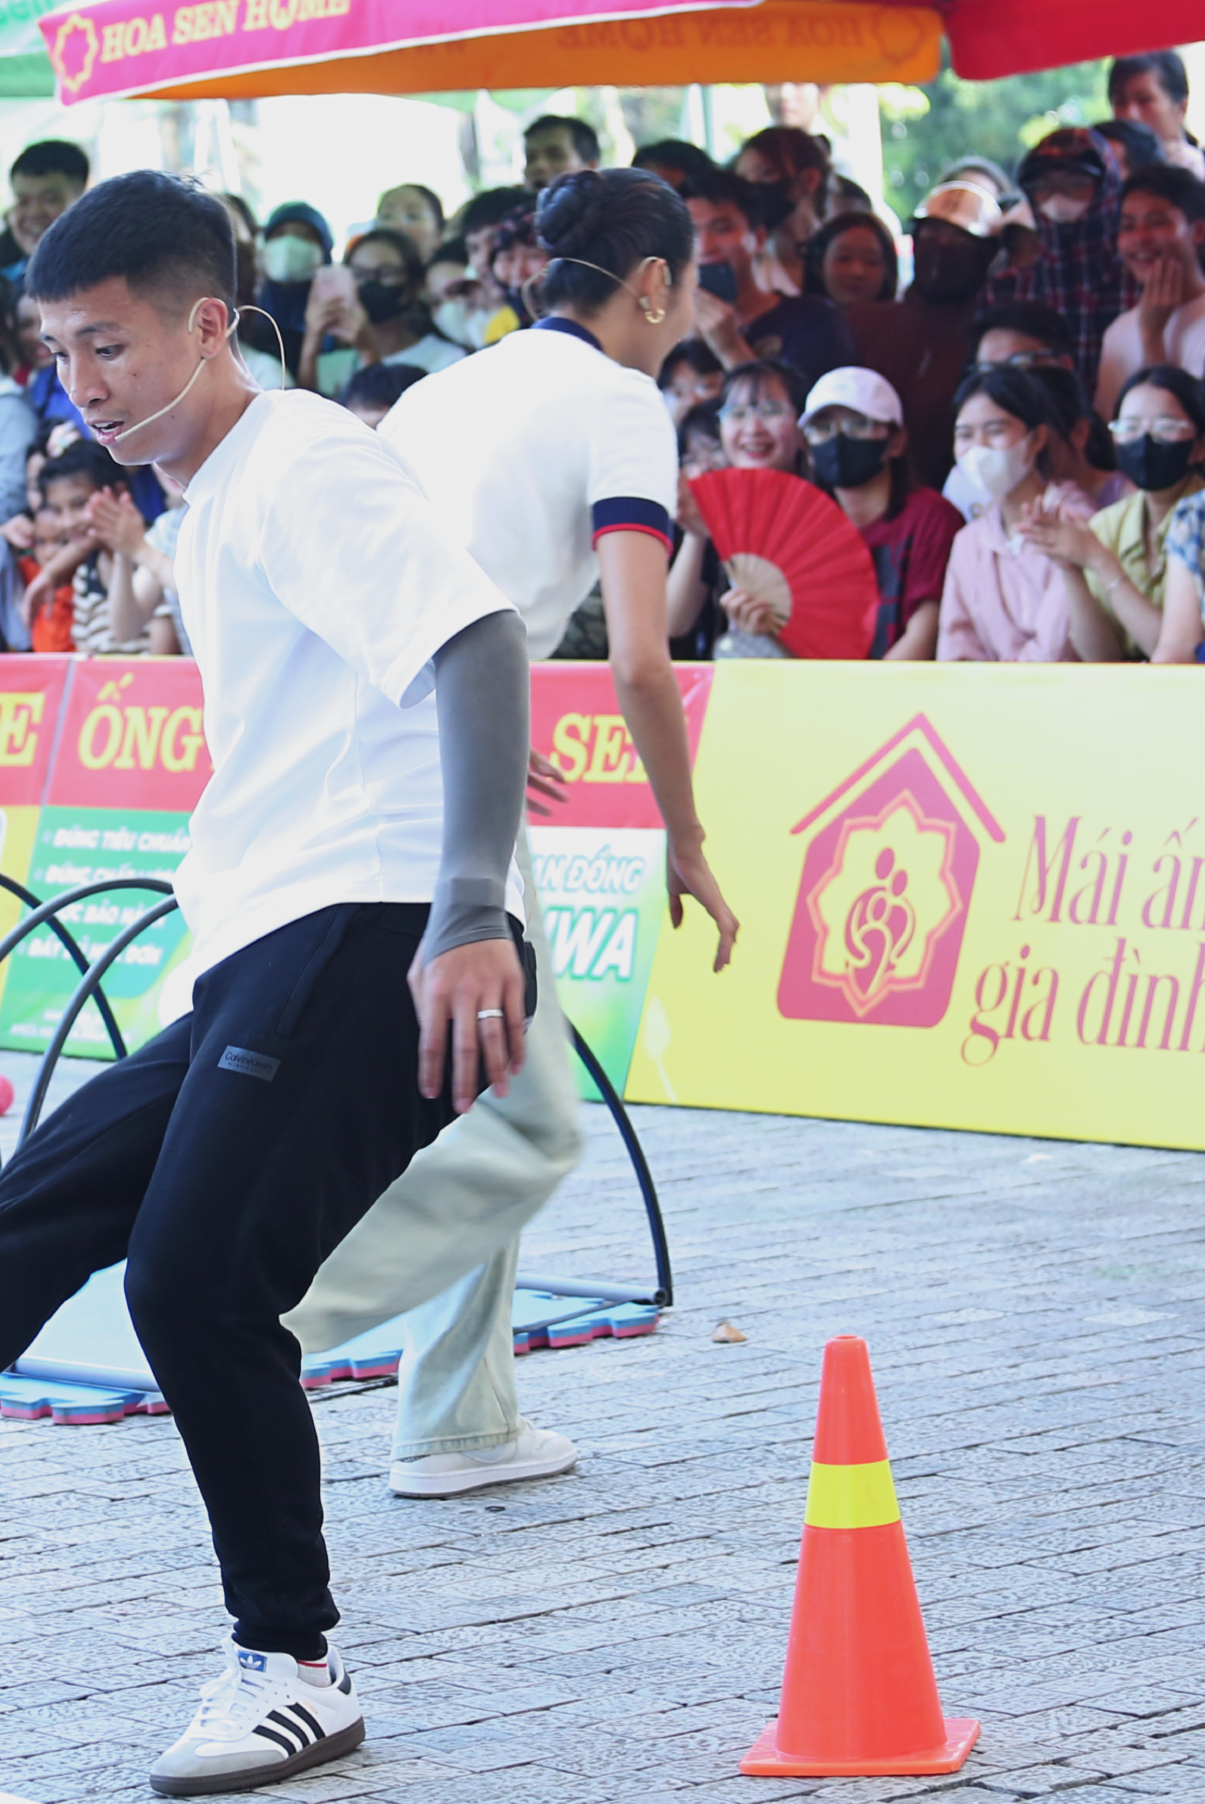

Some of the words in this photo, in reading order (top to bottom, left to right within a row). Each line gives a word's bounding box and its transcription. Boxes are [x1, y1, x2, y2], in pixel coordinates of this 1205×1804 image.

[100, 13, 167, 63] HOA
[171, 0, 241, 44] SEN
[77, 671, 205, 774] ỐNG
[1010, 814, 1134, 926] Mái
[960, 943, 1060, 1068] gia
